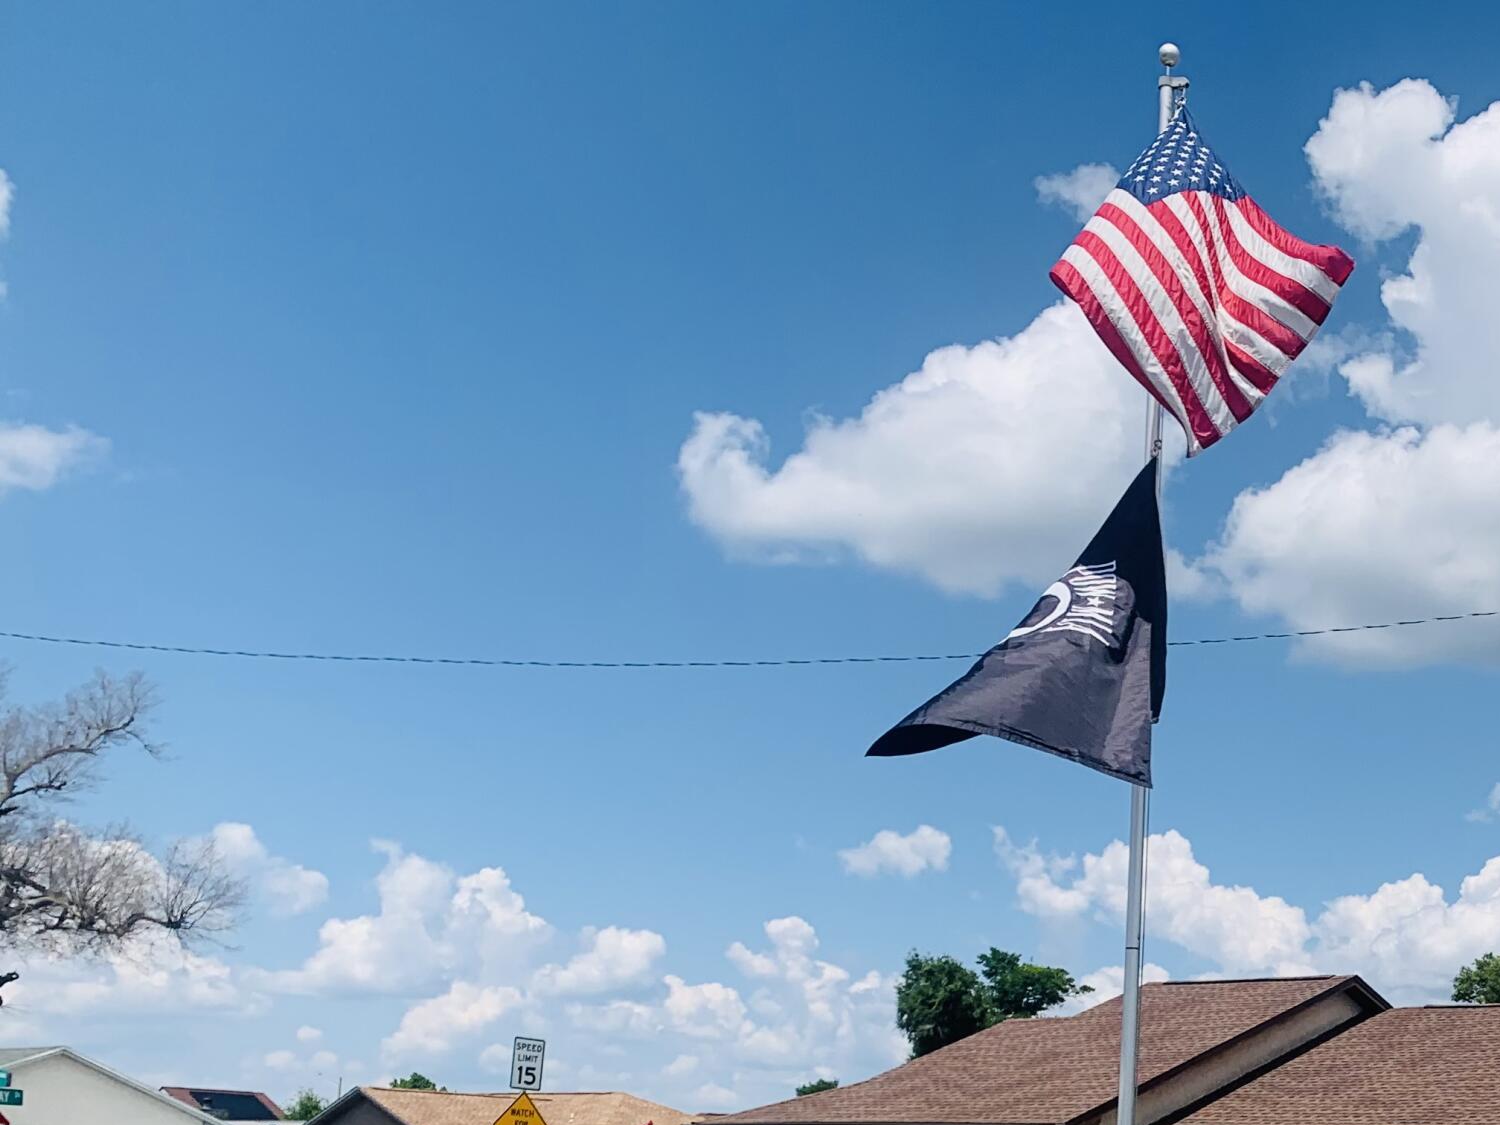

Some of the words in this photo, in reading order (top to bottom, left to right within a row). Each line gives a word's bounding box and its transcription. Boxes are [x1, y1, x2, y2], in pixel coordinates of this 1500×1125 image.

[517, 1042, 542, 1052] SPEED
[517, 1054, 538, 1063] LIMIT
[517, 1066, 536, 1085] 15
[511, 1109, 535, 1118] WATCH
